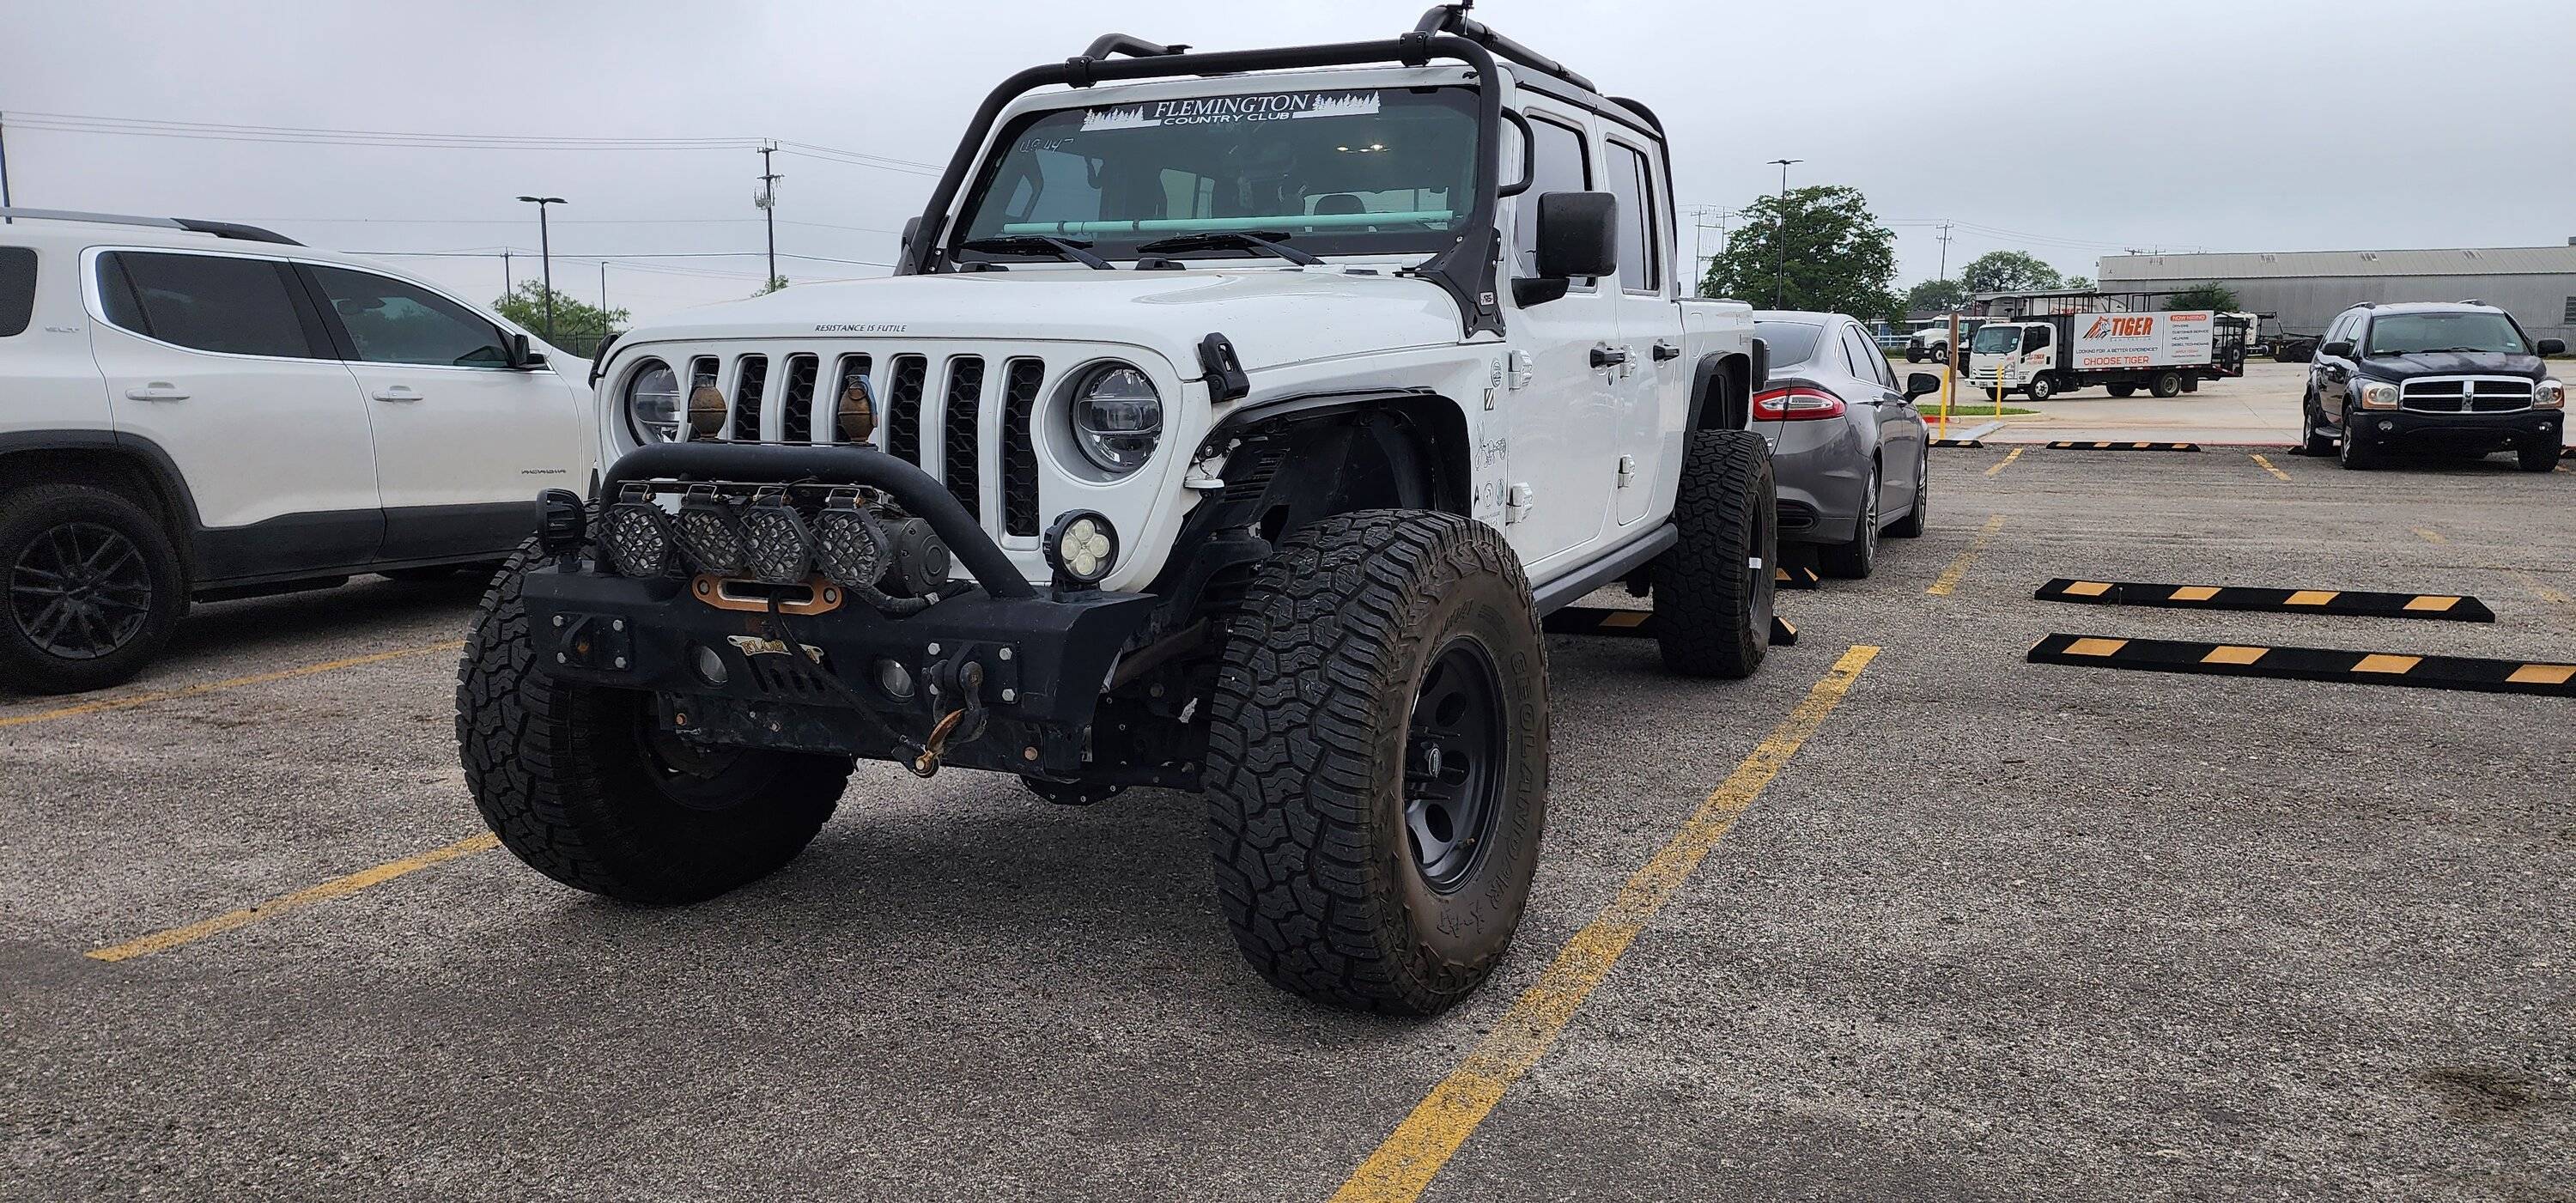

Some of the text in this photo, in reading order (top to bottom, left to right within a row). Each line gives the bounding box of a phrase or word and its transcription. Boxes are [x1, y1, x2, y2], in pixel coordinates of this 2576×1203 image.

[1154, 94, 1310, 118] FLEMINGTON
[1163, 112, 1291, 125] COUNTRY CLUB
[2111, 317, 2154, 336] TIGER
[2083, 357, 2122, 366] CHOOSE
